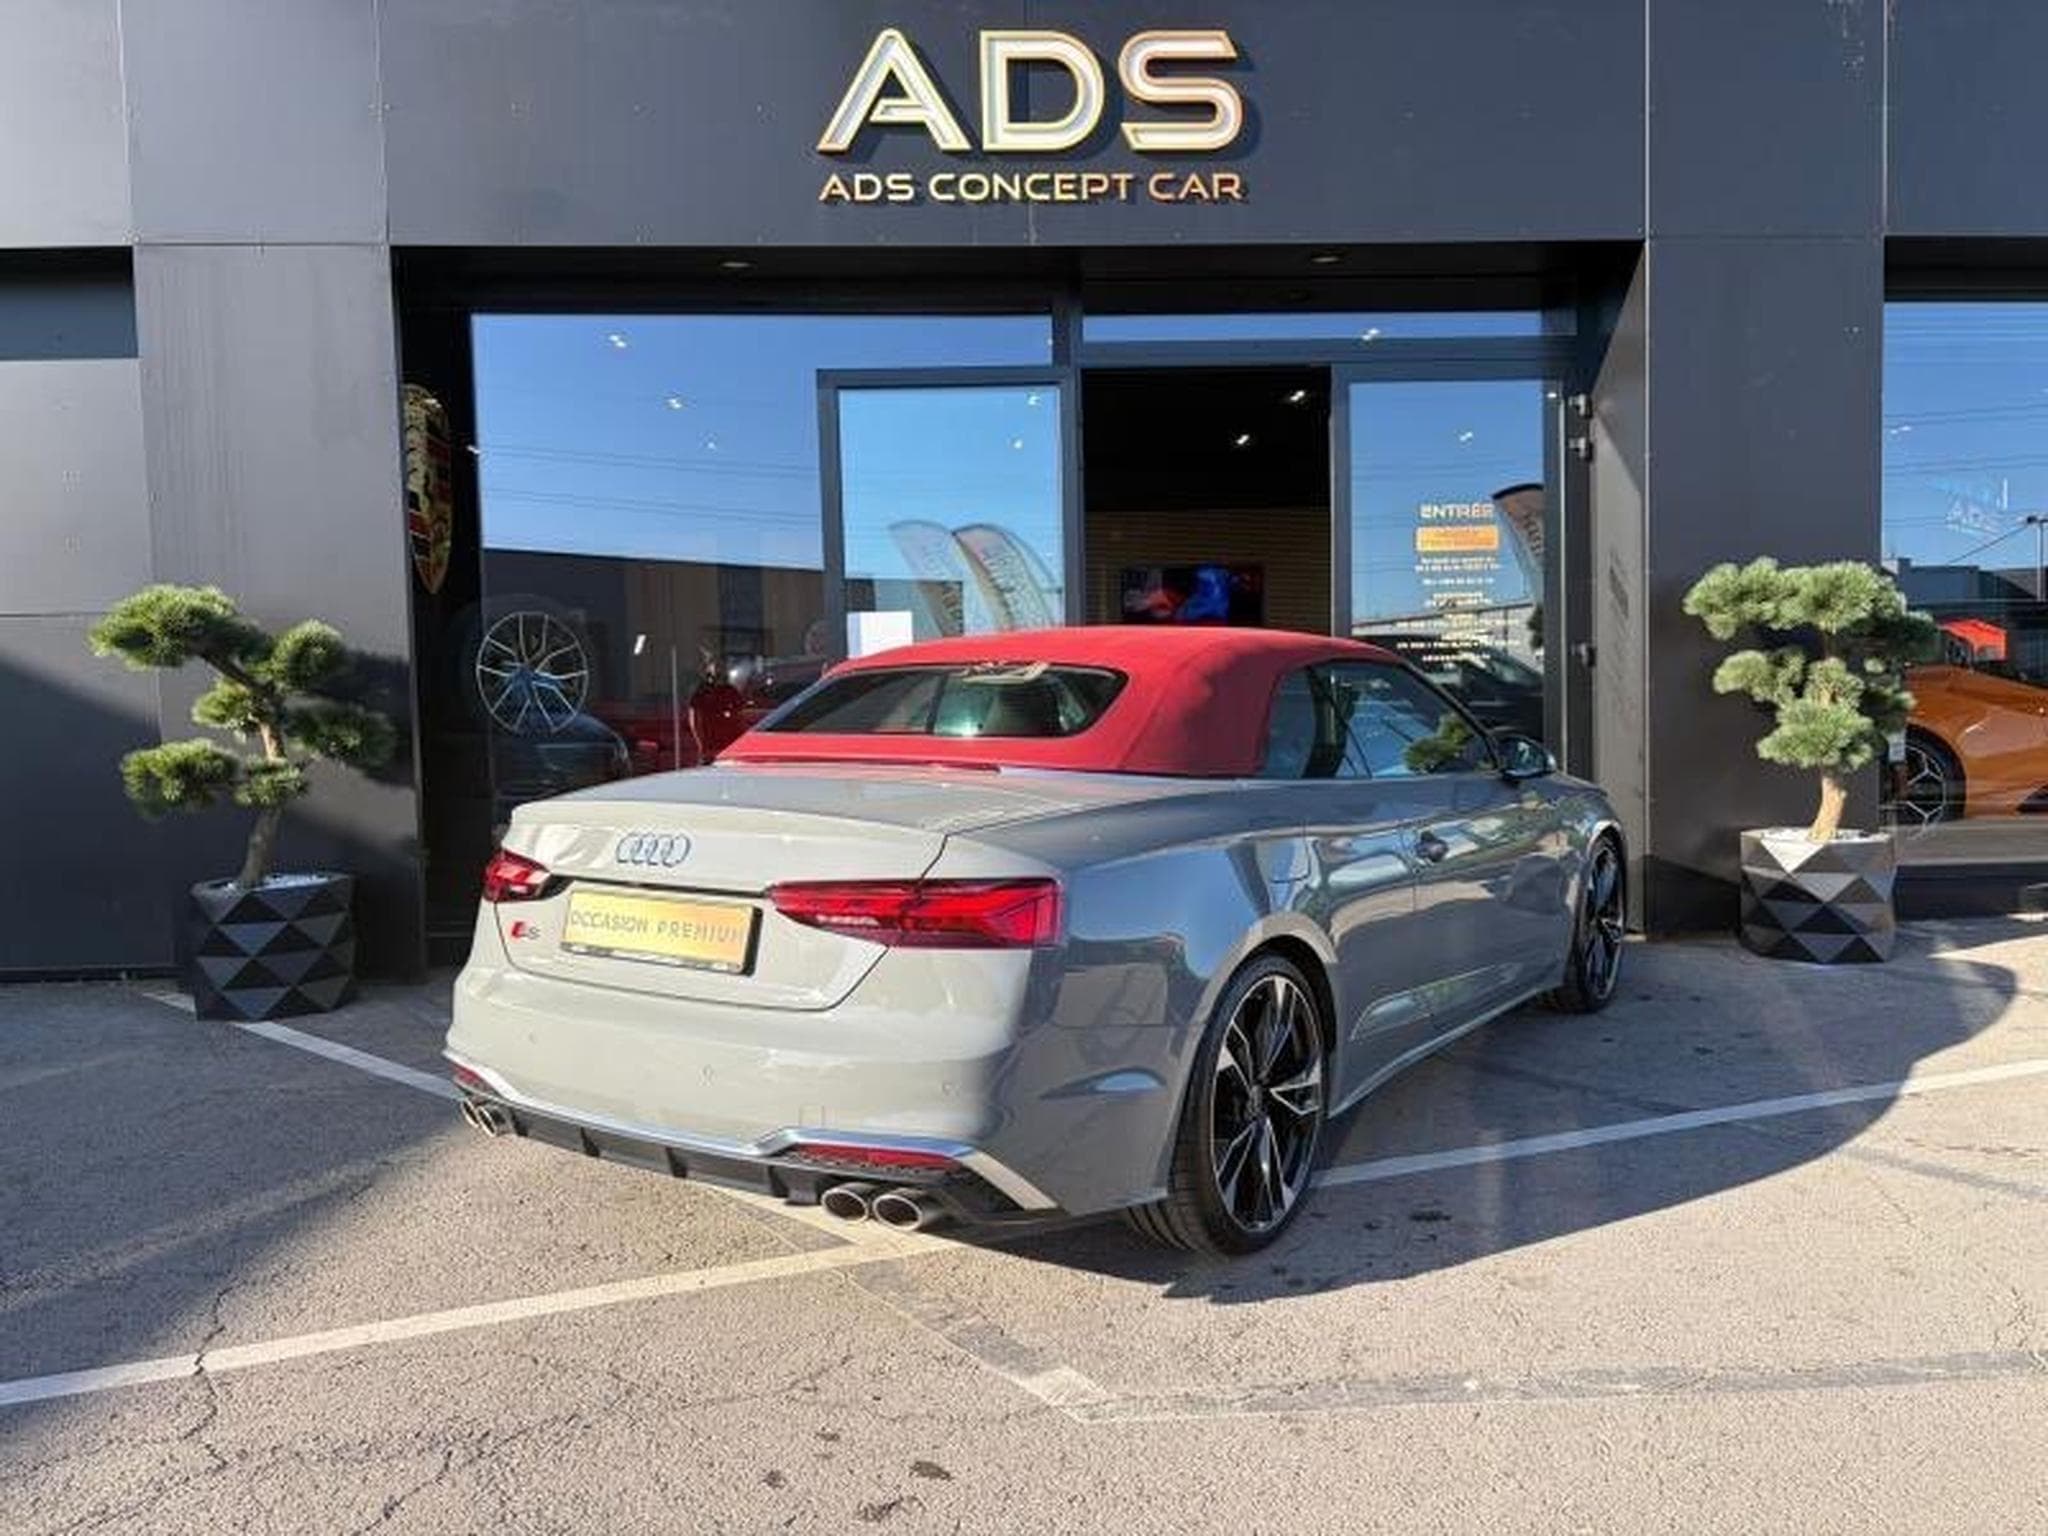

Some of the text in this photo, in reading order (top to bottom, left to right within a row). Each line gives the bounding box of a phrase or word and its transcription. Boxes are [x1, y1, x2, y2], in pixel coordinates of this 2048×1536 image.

[816, 28, 1243, 152] ADS
[818, 173, 1243, 202] ADS CONCEPT CAR
[570, 910, 648, 935] OCCASION
